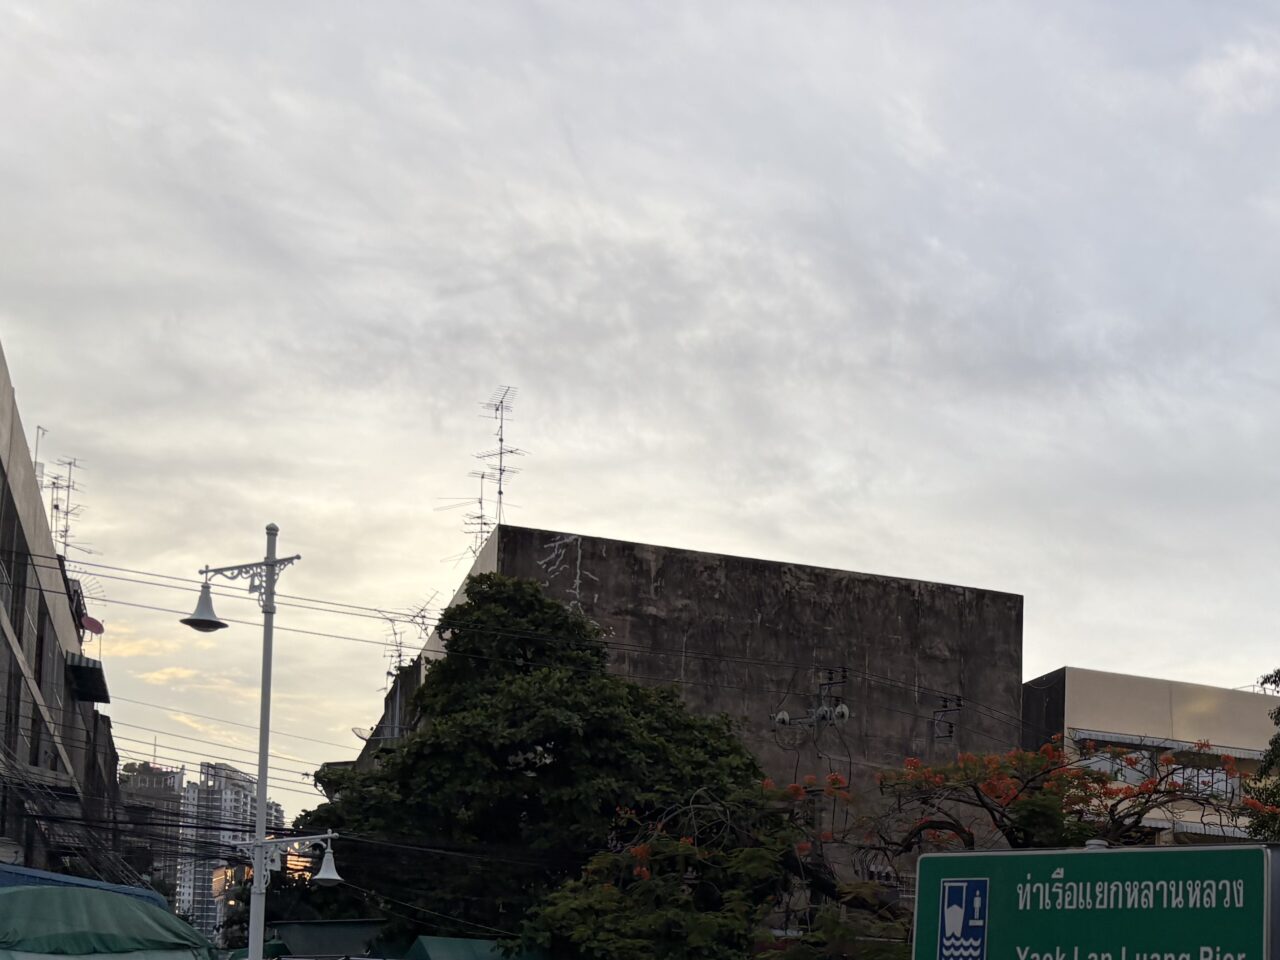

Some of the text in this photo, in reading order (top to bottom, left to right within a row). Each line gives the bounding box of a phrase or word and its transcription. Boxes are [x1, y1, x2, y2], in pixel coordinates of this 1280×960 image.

[1016, 867, 1244, 910] ท่าเรือแยกหลานหลวง
